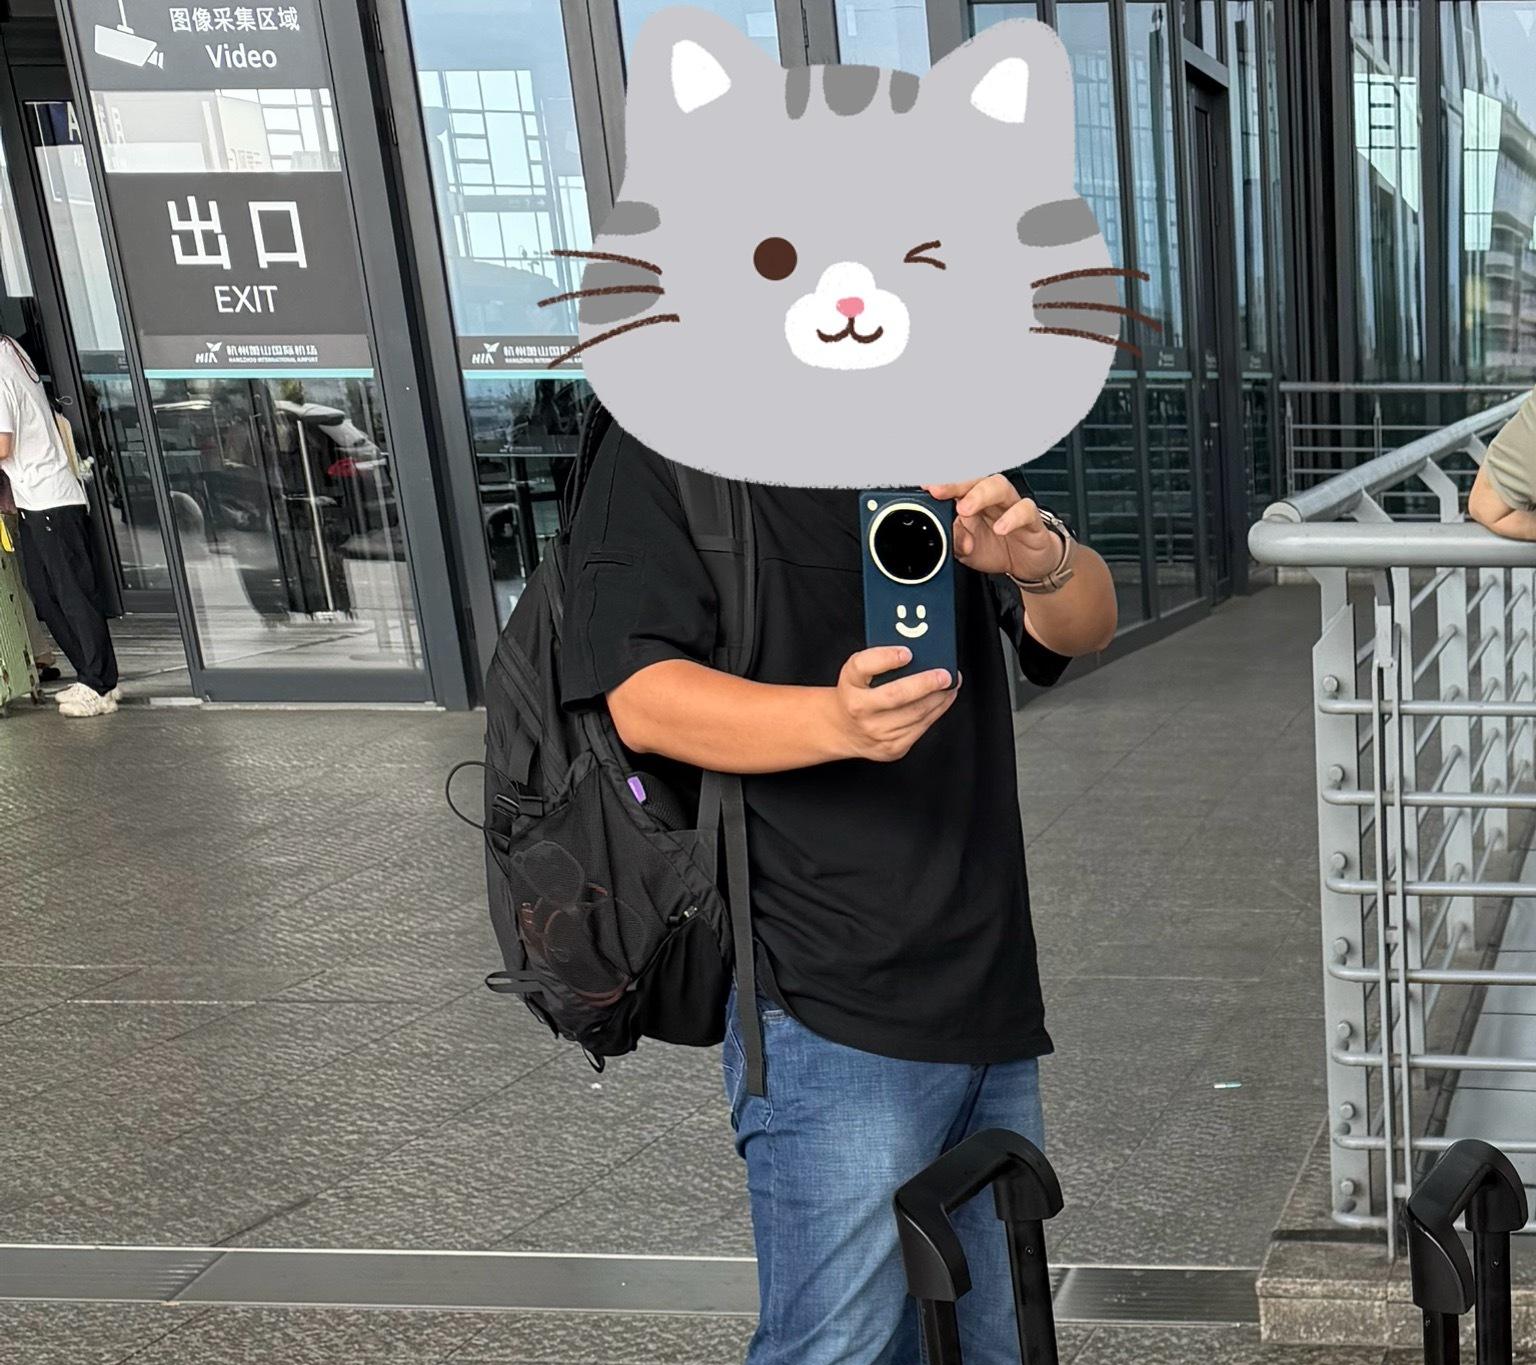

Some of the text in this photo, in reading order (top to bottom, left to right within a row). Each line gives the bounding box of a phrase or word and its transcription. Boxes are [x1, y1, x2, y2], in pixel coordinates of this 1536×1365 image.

[169, 6, 300, 33] 图像采集区域
[205, 42, 278, 69] Video
[167, 195, 308, 270] 出口
[214, 285, 278, 313] EXIT
